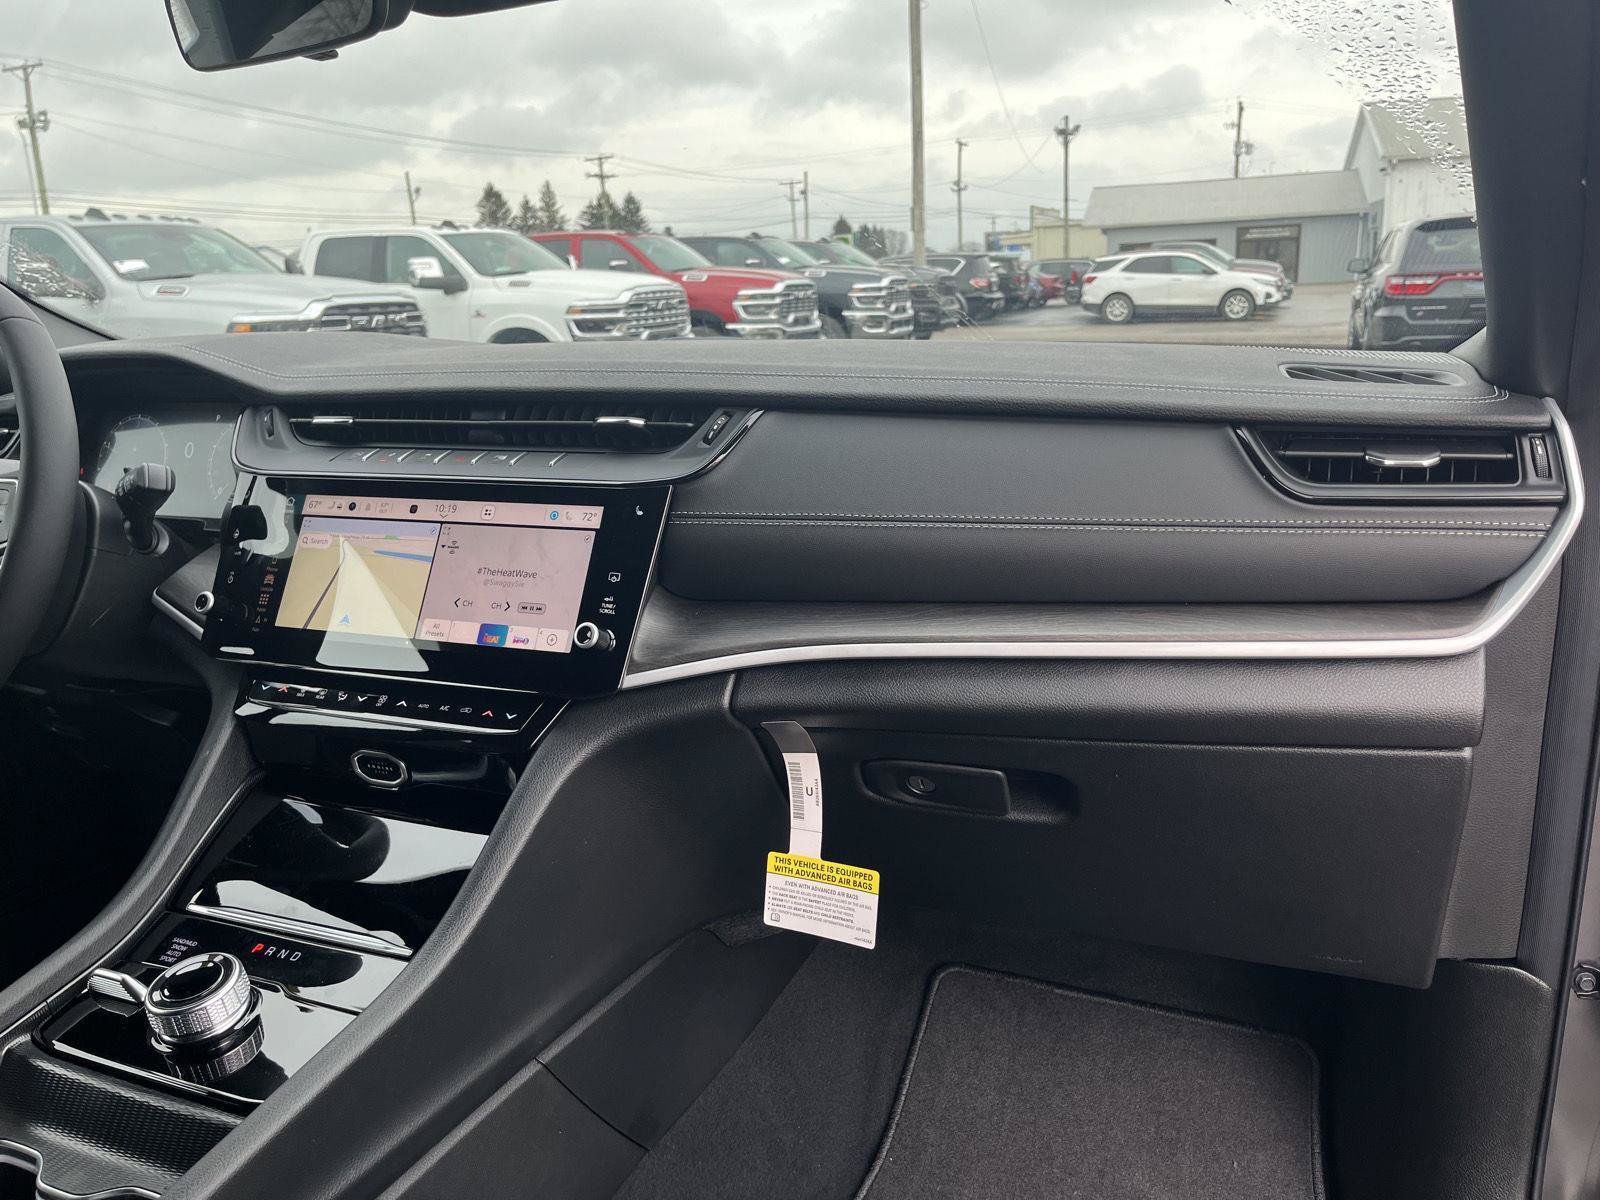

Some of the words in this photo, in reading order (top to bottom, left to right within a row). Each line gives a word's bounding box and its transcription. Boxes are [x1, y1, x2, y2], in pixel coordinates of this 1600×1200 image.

[435, 504, 457, 513] 10:19
[582, 512, 598, 521] 72°
[477, 567, 538, 579] #TheHeatWave
[491, 602, 502, 610] CH
[805, 786, 813, 797] U
[775, 856, 791, 866] THIS
[794, 860, 824, 872] VEHICLE
[827, 866, 834, 874] IS
[836, 867, 873, 881] EQUIPPED
[774, 864, 793, 875] WITH
[795, 868, 836, 883] ADVANCED
[838, 877, 851, 886] AIR
[853, 880, 873, 891] BAGS
[785, 880, 797, 888] EVEN
[811, 886, 836, 896] ADVANCED
[166, 949, 182, 957] AUTO
[251, 943, 265, 953] P
[264, 946, 277, 956] R
[276, 949, 290, 959] N
[289, 951, 302, 962] D
[159, 955, 177, 963] SPORT
